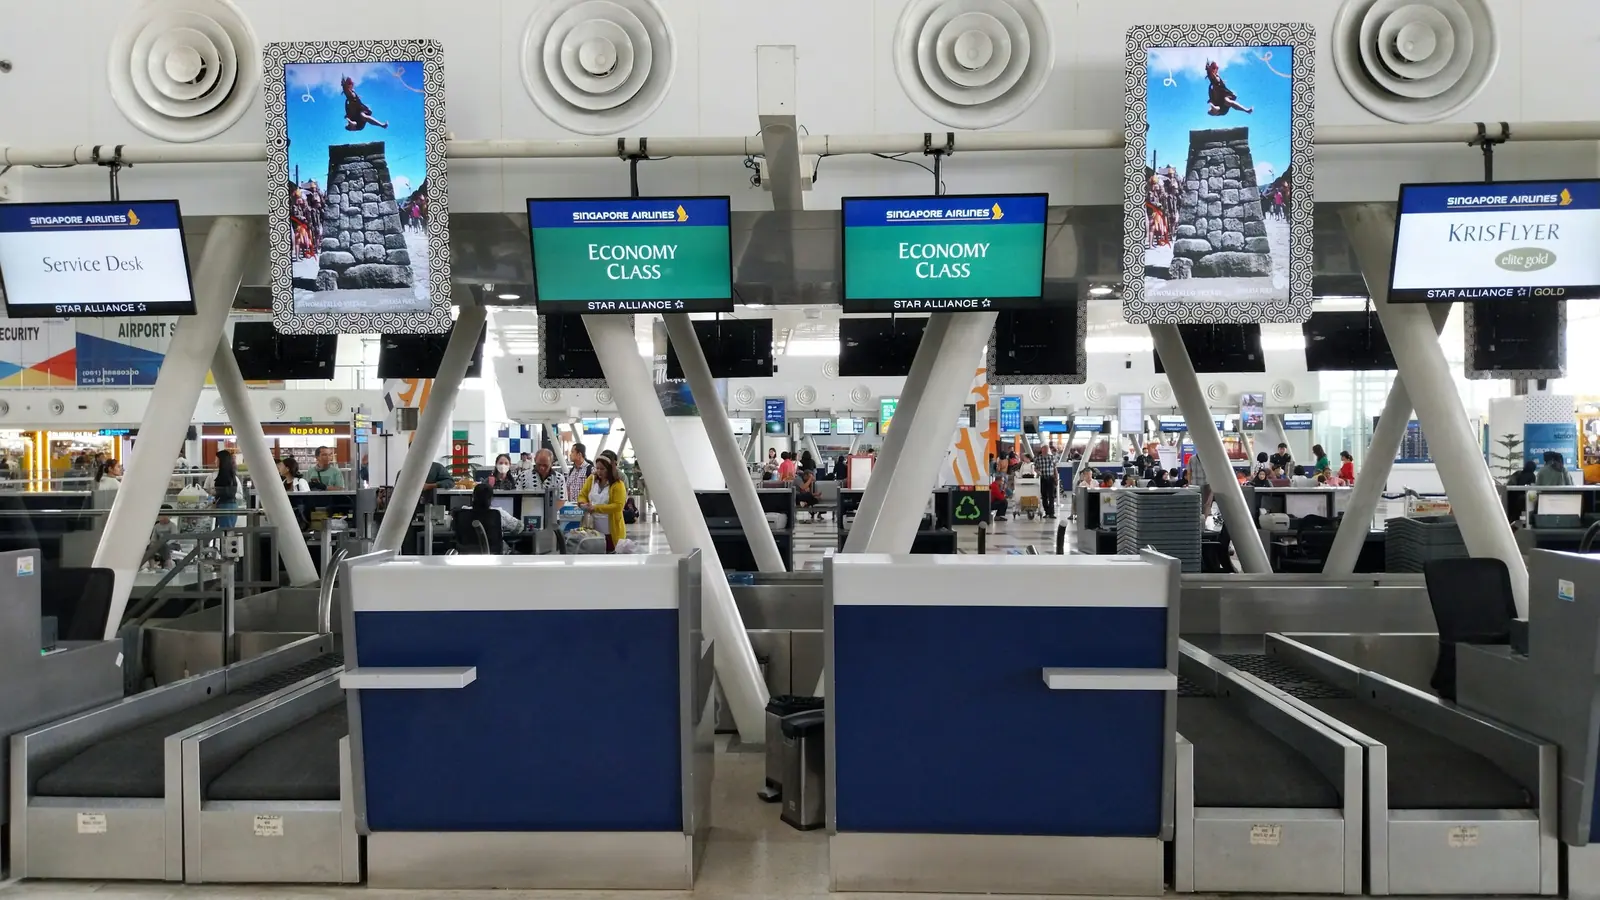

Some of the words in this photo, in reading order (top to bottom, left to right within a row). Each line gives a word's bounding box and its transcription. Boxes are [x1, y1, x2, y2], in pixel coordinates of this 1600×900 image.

[1446, 195, 1508, 206] SINGAPORE
[1509, 194, 1558, 204] AIRLINES
[29, 215, 83, 225] SINGAPORE
[85, 214, 127, 224] AIRLINES
[572, 211, 629, 220] SINGAPORE
[631, 210, 675, 219] AIRLINES
[886, 209, 943, 219] SINGAPORE
[944, 208, 990, 218] AIRLINES
[588, 243, 678, 260] ECONOMY
[898, 242, 991, 259] ECONOMY
[42, 256, 101, 272] Service
[105, 255, 144, 272] Desk
[1501, 253, 1523, 265] elite
[1524, 252, 1549, 268] gold
[606, 263, 662, 280] CLASS
[915, 261, 971, 279] CLASS
[1426, 289, 1456, 298] STAR
[1458, 288, 1514, 297] ALLIANCE
[1534, 287, 1565, 297] GOLD
[55, 304, 82, 313] STAR
[84, 303, 135, 313] ALLIANCE
[588, 301, 616, 310] STAR
[618, 300, 672, 309] ALLIANCE
[893, 300, 921, 309] STAR
[924, 299, 979, 308] ALLIANCE
[118, 323, 167, 338] AIRPORT
